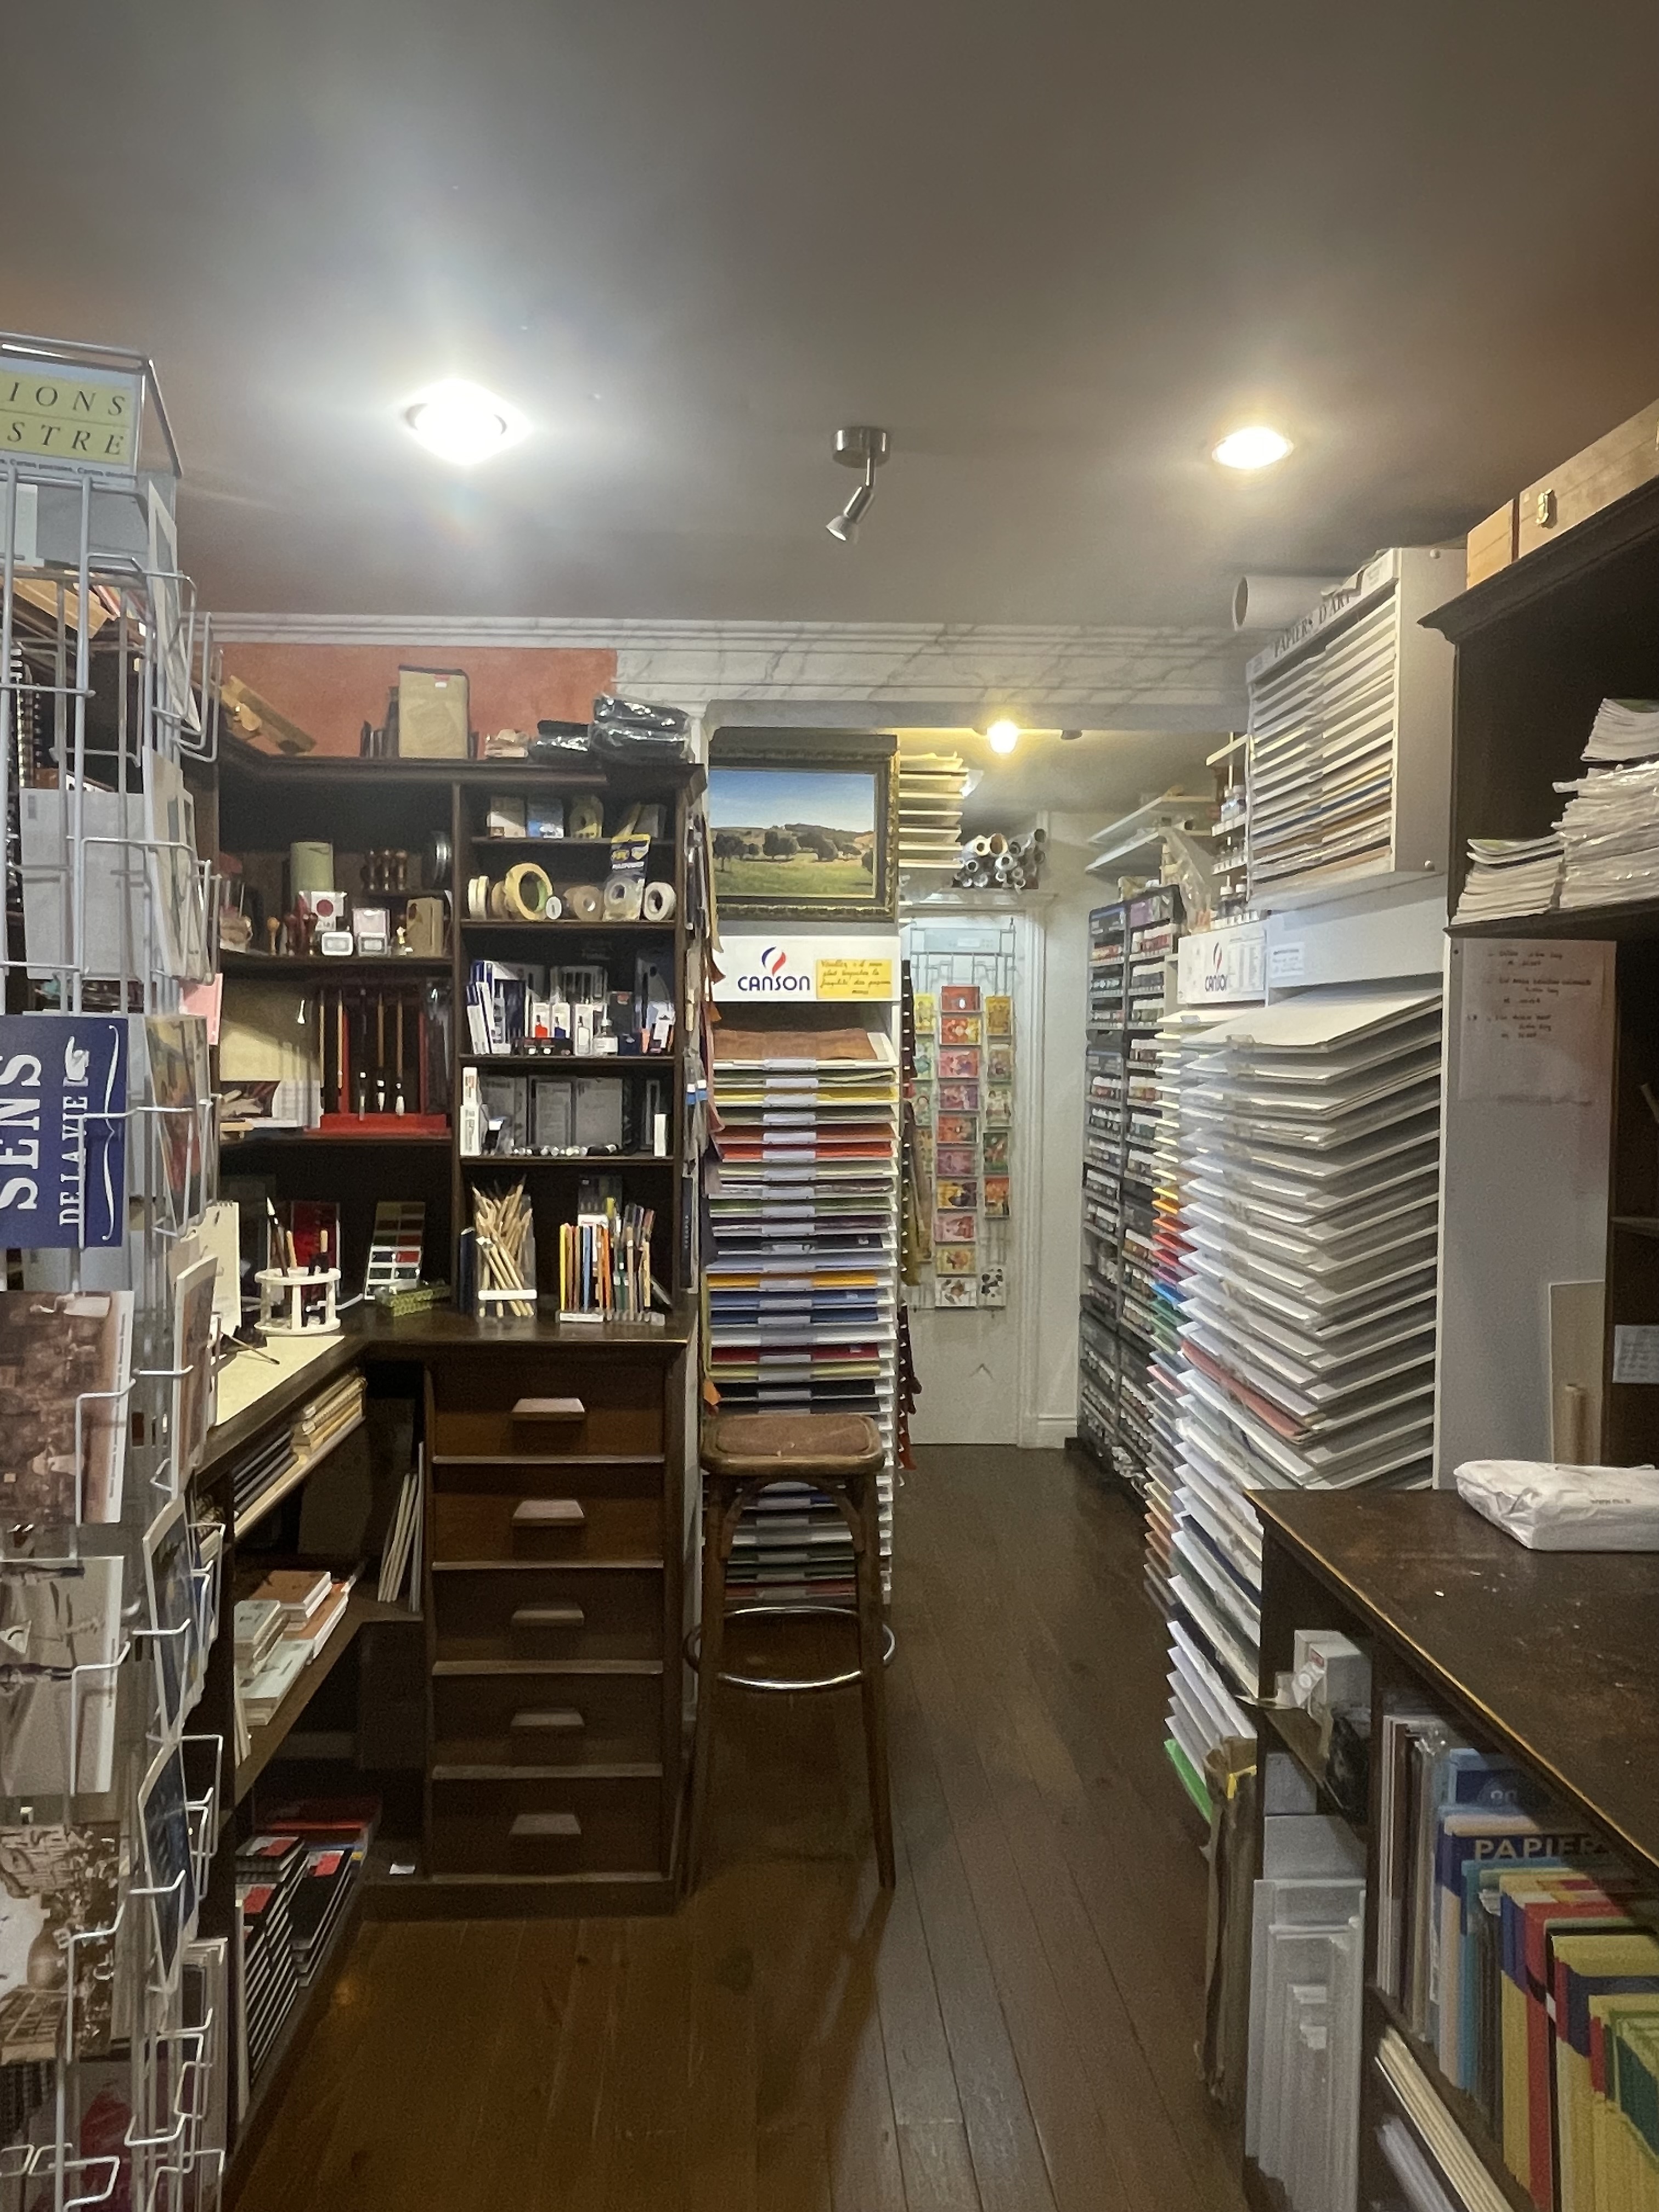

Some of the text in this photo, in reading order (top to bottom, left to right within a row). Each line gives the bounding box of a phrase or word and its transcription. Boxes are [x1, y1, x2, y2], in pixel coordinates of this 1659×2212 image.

[9, 382, 126, 416] IONS
[7, 422, 124, 455] STRE
[737, 975, 810, 991] CANSON
[0, 1054, 42, 1210] SENS
[62, 1096, 88, 1141] VIE
